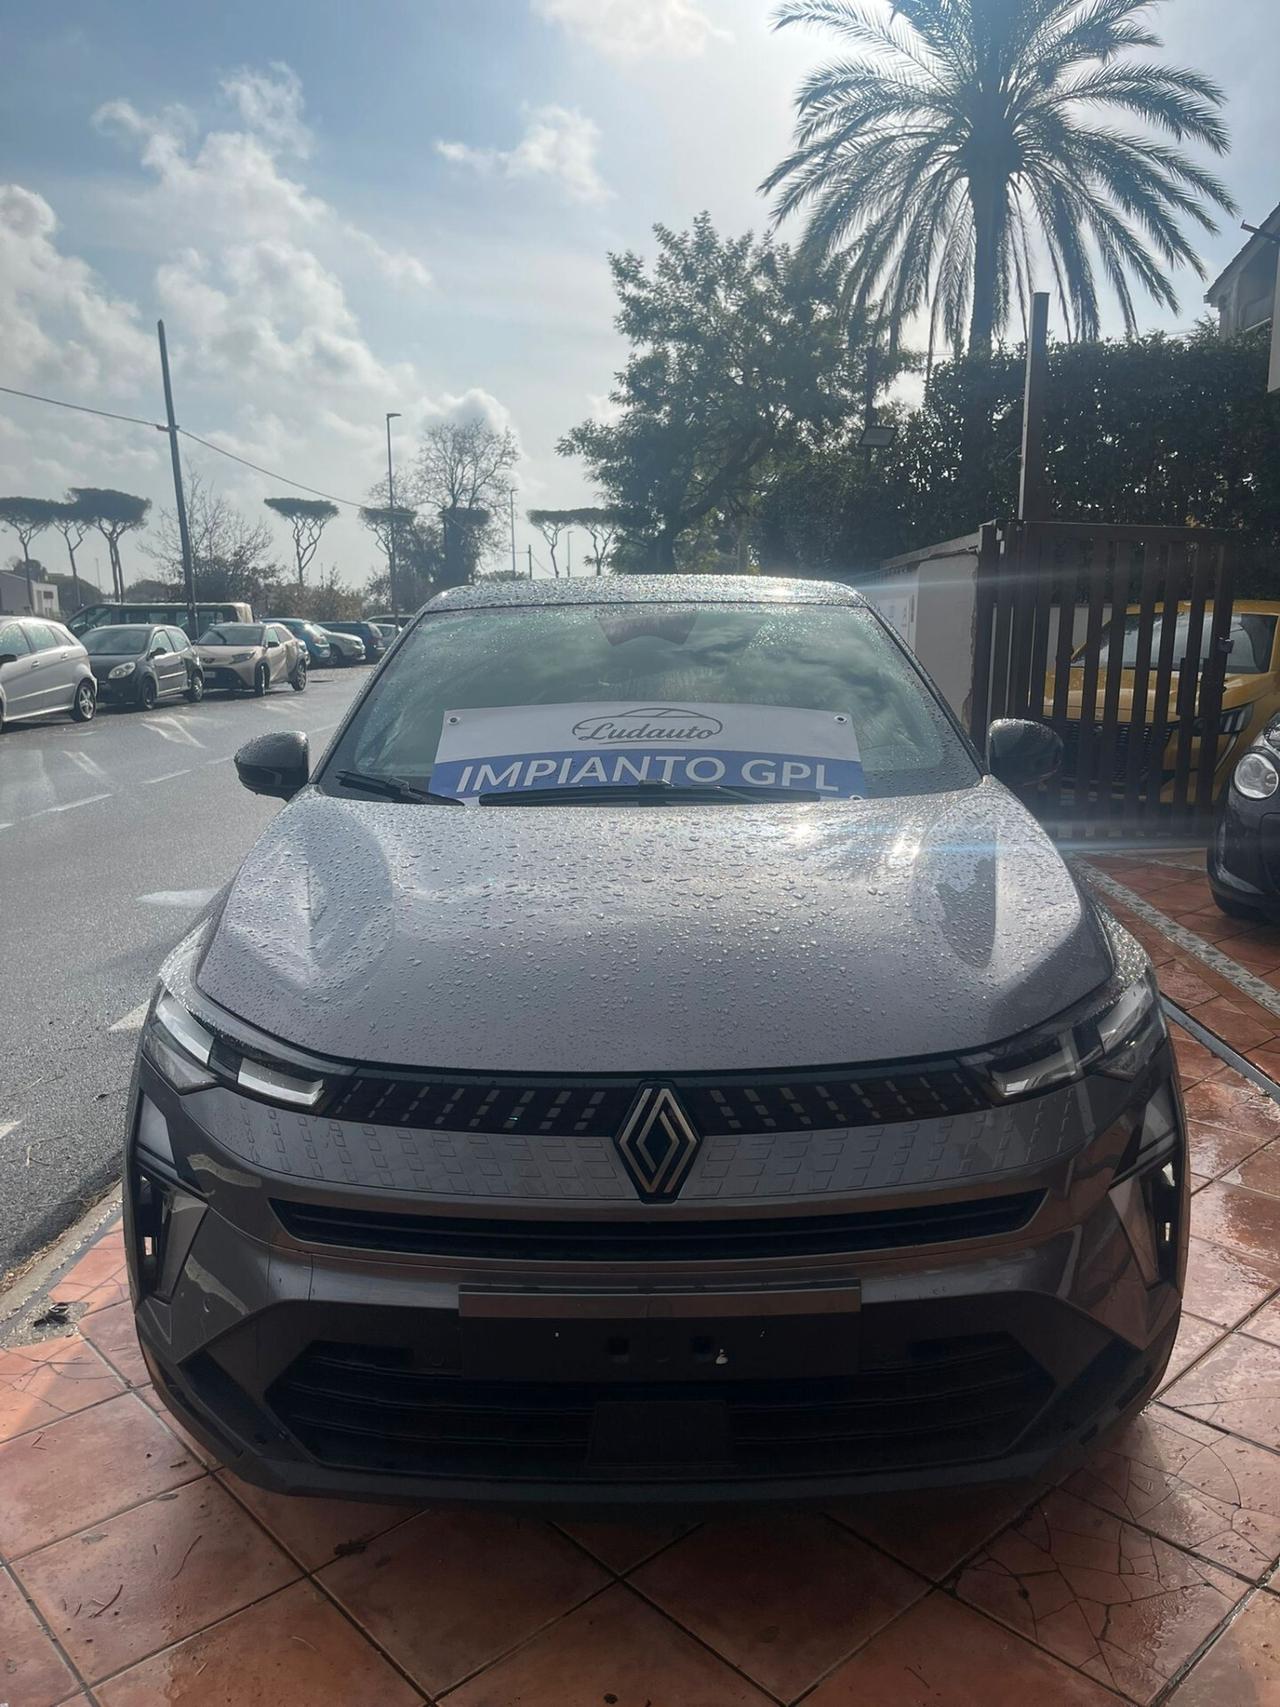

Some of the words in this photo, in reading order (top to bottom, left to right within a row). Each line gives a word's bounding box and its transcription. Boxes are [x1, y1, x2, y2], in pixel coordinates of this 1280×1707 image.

[578, 722, 714, 741] Ludauto
[456, 756, 726, 793] IMPIANTO
[741, 759, 839, 792] GPL
